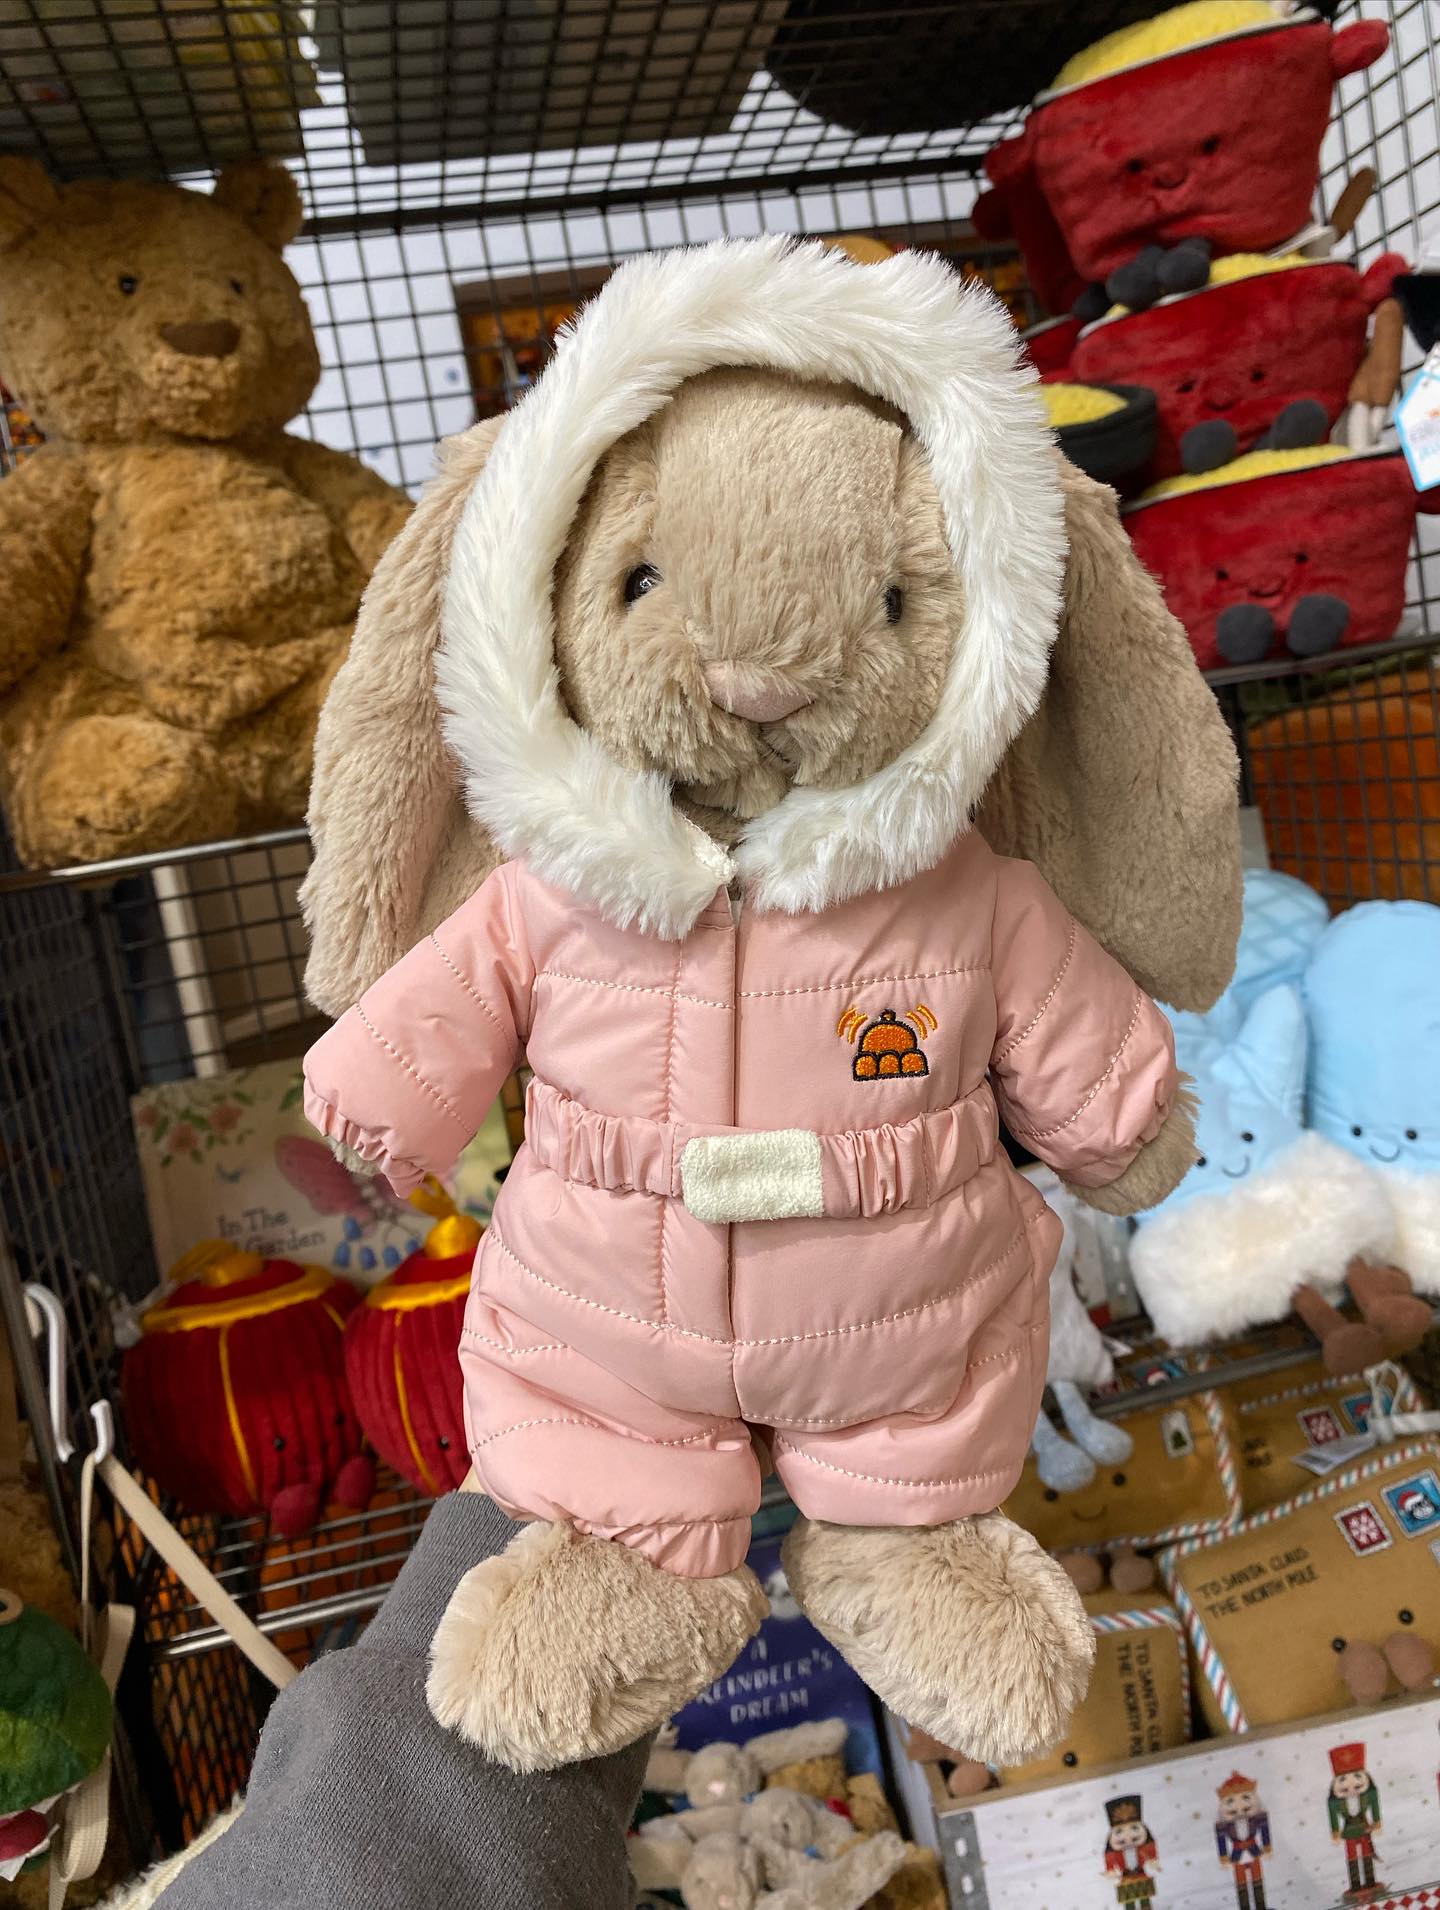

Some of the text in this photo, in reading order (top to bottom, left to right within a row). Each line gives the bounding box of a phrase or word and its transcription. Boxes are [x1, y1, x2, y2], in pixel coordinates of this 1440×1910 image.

[215, 1206, 289, 1239] In The
[244, 1229, 327, 1256] Garden
[1204, 1563, 1320, 1619] THE NORTH POLE
[1221, 1561, 1268, 1591] SANTA
[750, 1637, 767, 1661] A
[1117, 1640, 1133, 1679] THE
[729, 1687, 809, 1724] DREAM
[1123, 1681, 1142, 1731] NORTH
